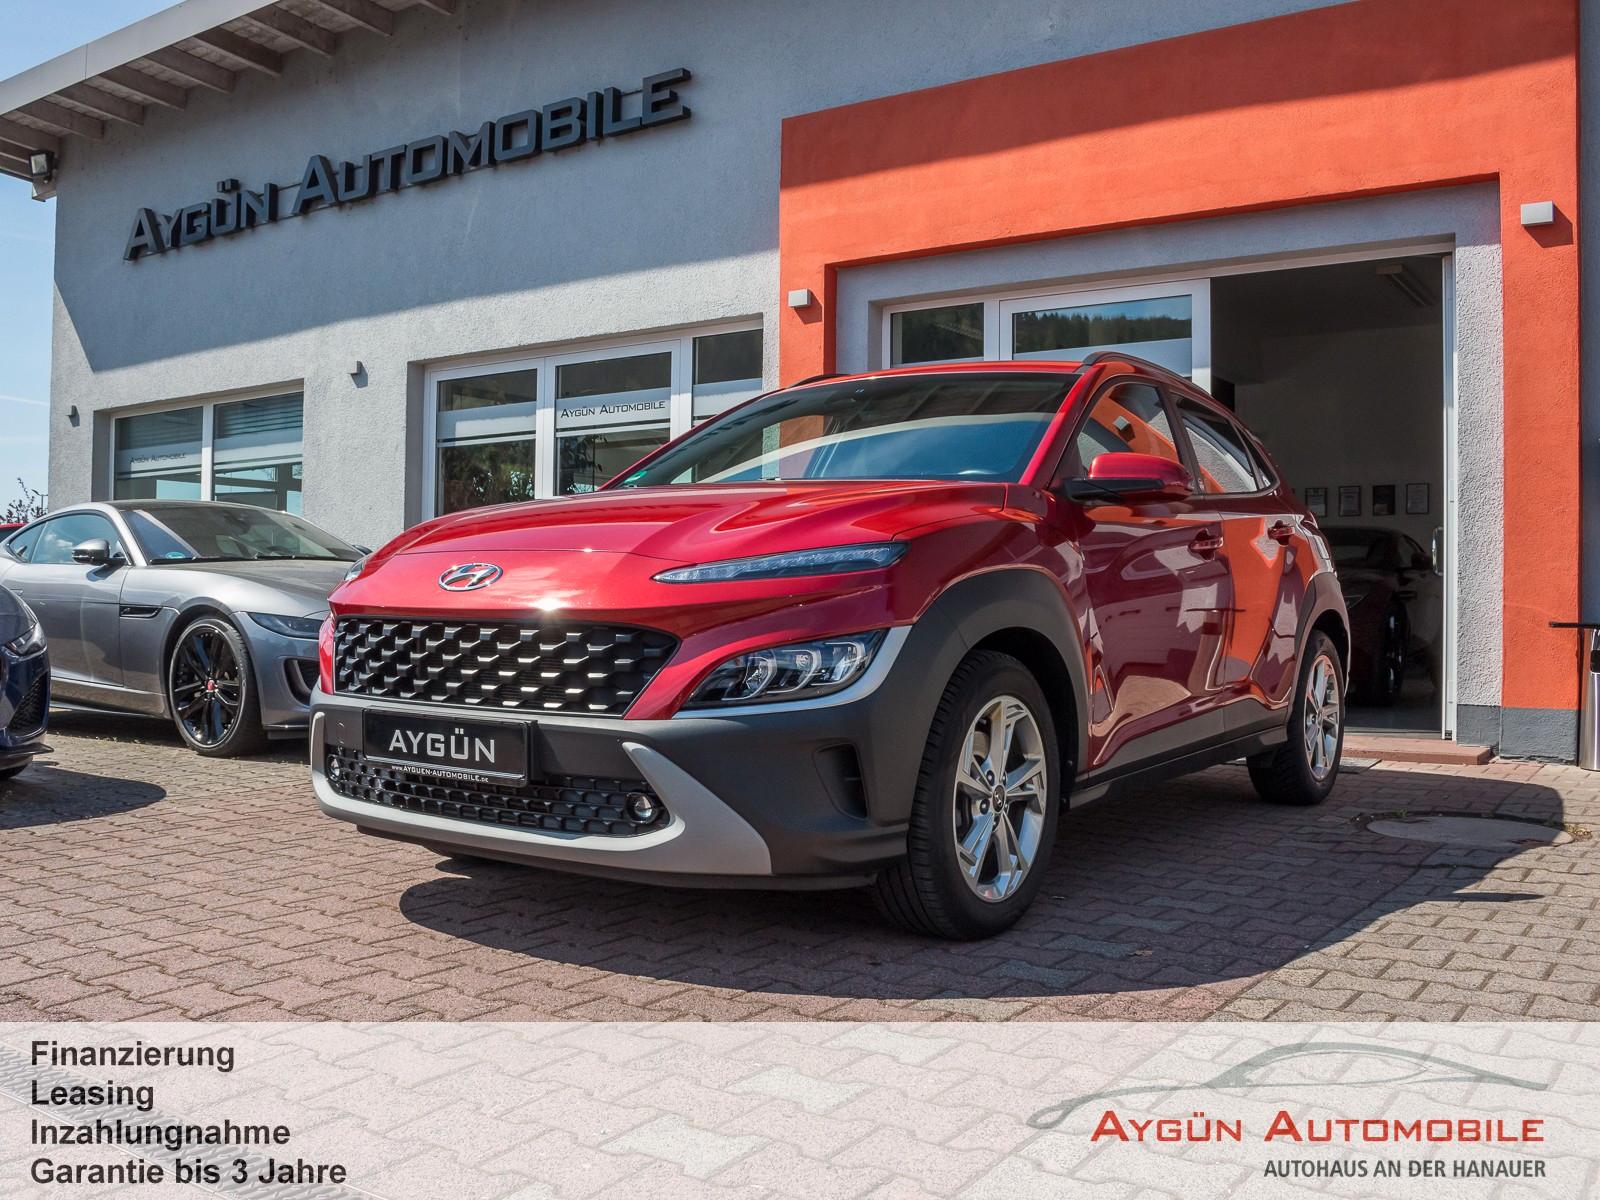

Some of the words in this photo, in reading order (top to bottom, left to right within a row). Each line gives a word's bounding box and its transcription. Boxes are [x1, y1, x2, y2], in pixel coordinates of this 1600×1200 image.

[123, 178, 278, 260] AYGÜN
[292, 67, 692, 214] AUTOMOBILE
[560, 405, 596, 418] AYGÜN
[599, 400, 666, 415] AUTOMOBILE
[388, 727, 495, 763] AYGÜN
